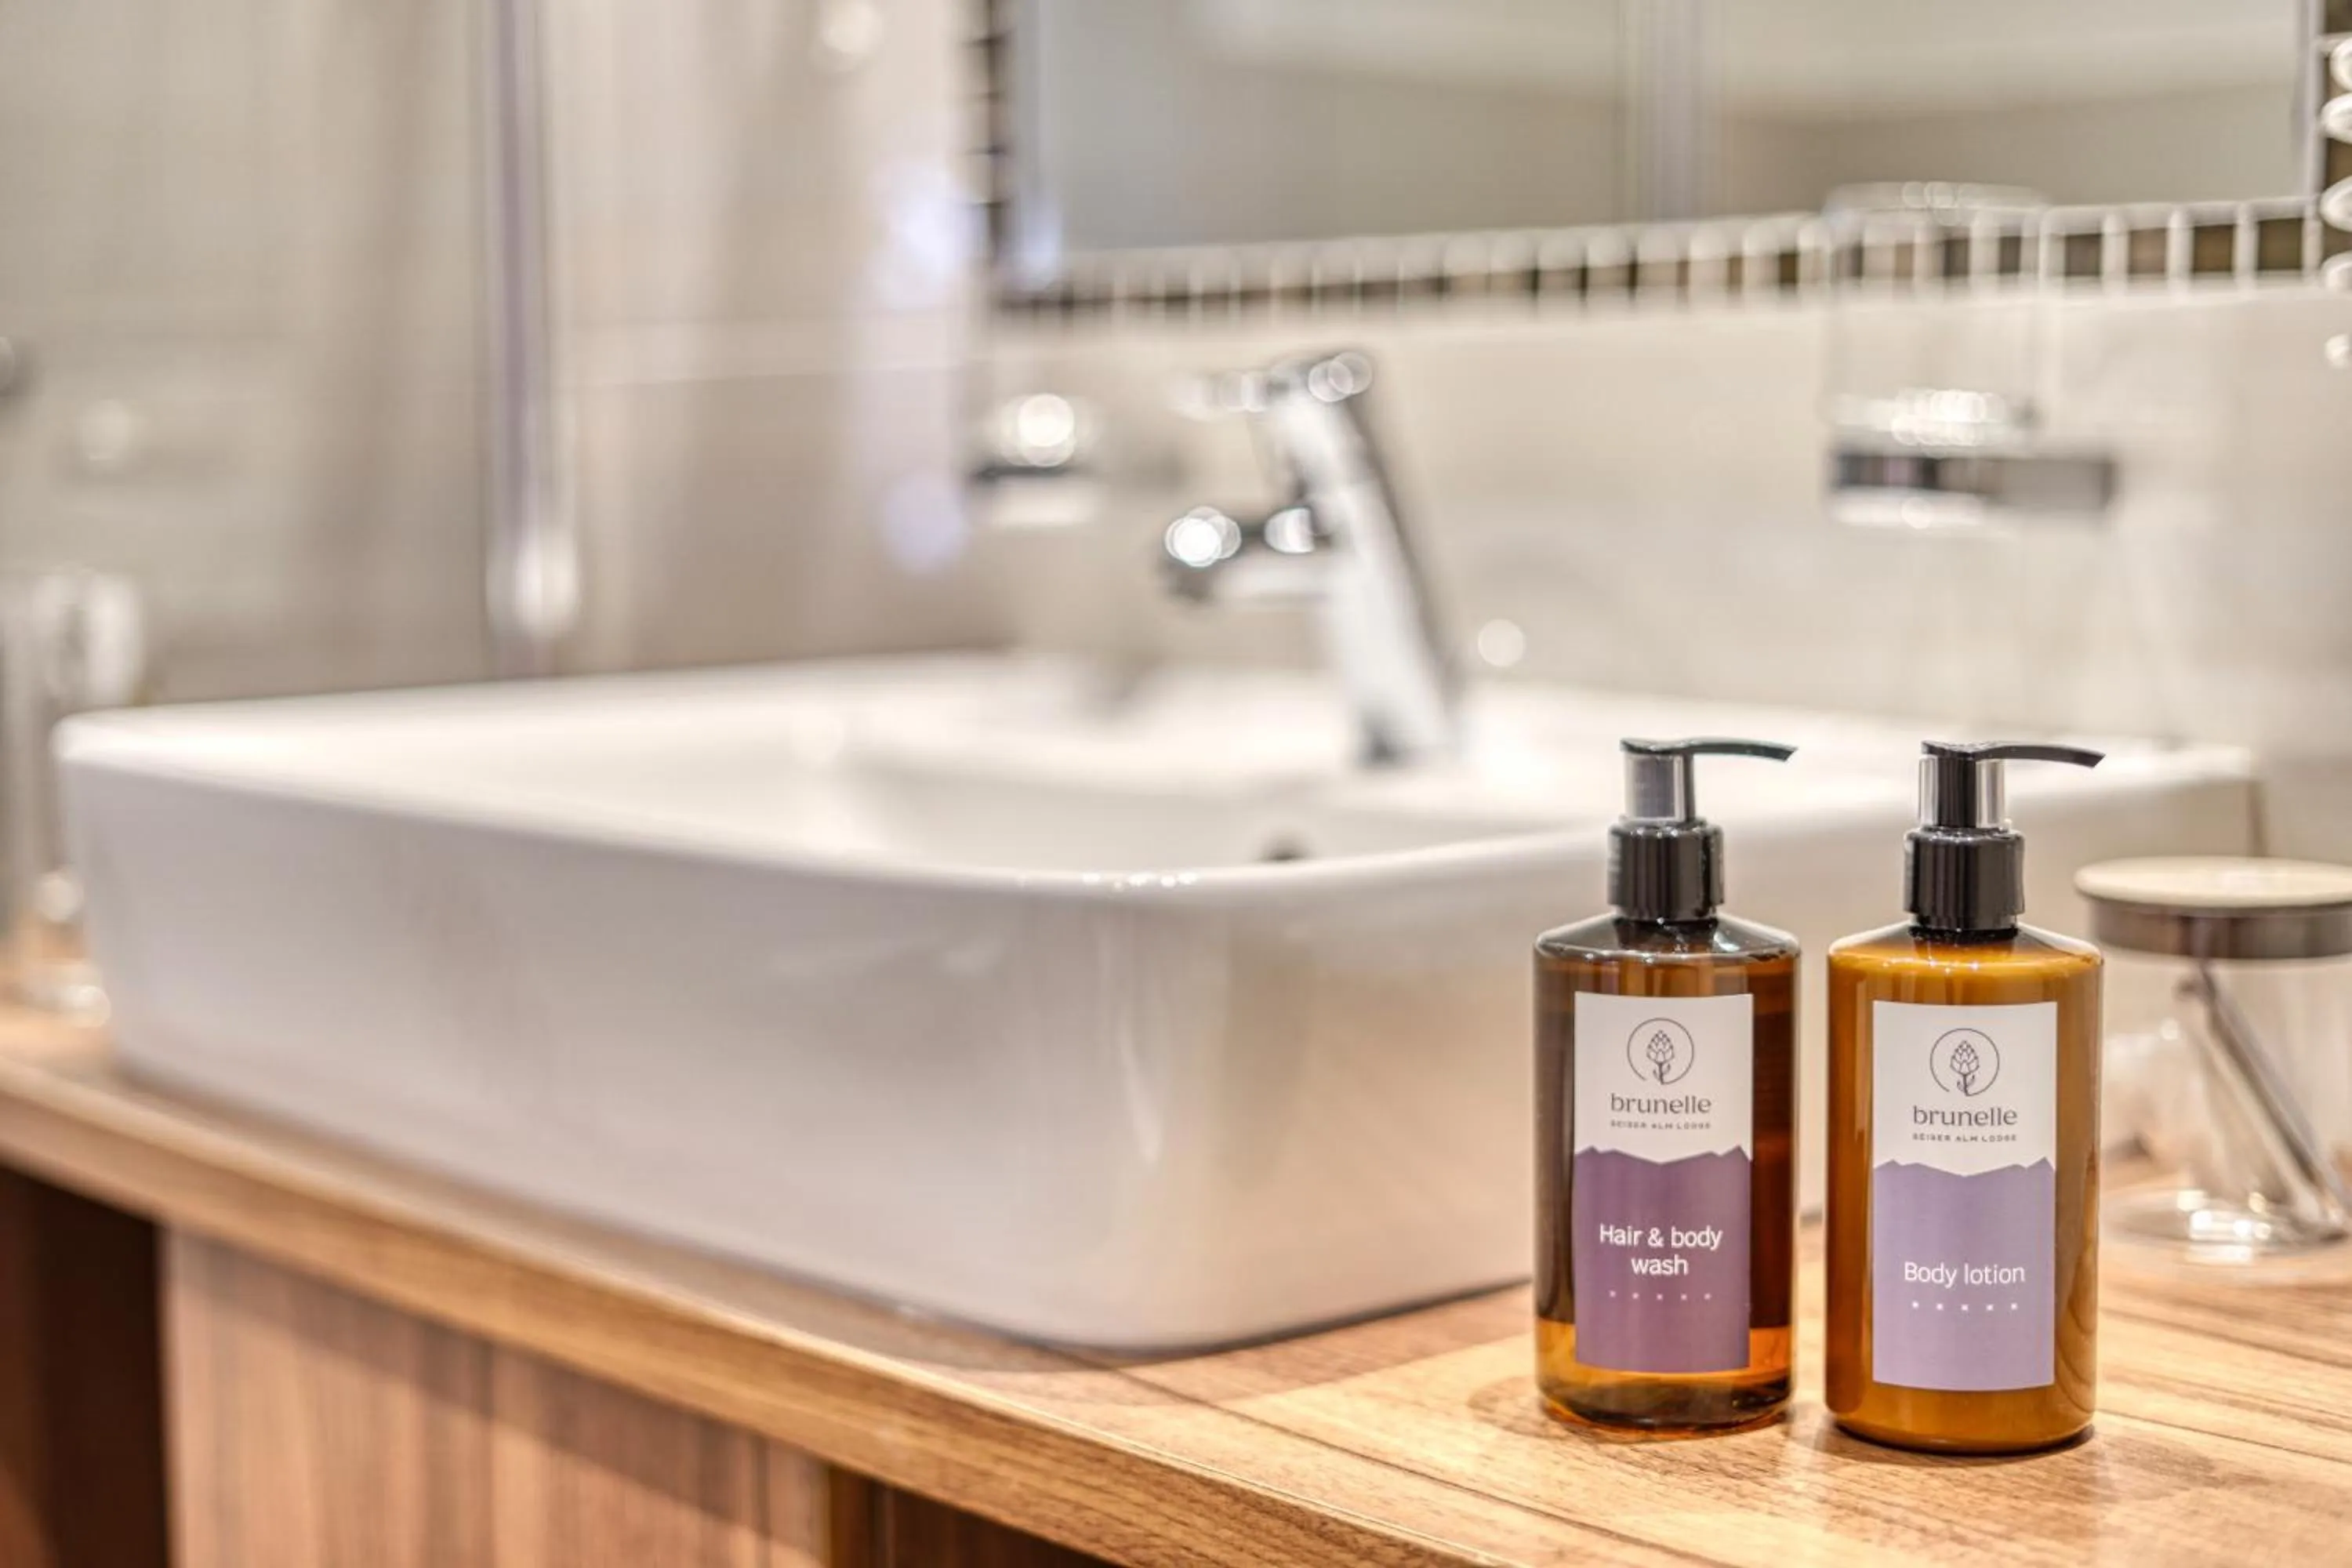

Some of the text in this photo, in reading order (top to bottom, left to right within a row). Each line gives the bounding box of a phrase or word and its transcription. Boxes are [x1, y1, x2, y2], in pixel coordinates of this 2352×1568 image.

[1610, 1092, 1711, 1114] brunelle
[1913, 1105, 2018, 1127] brunelle
[1599, 1223, 1723, 1251] Hair & body
[1631, 1254, 1689, 1276] wash
[1904, 1261, 2026, 1290] Body lotion
